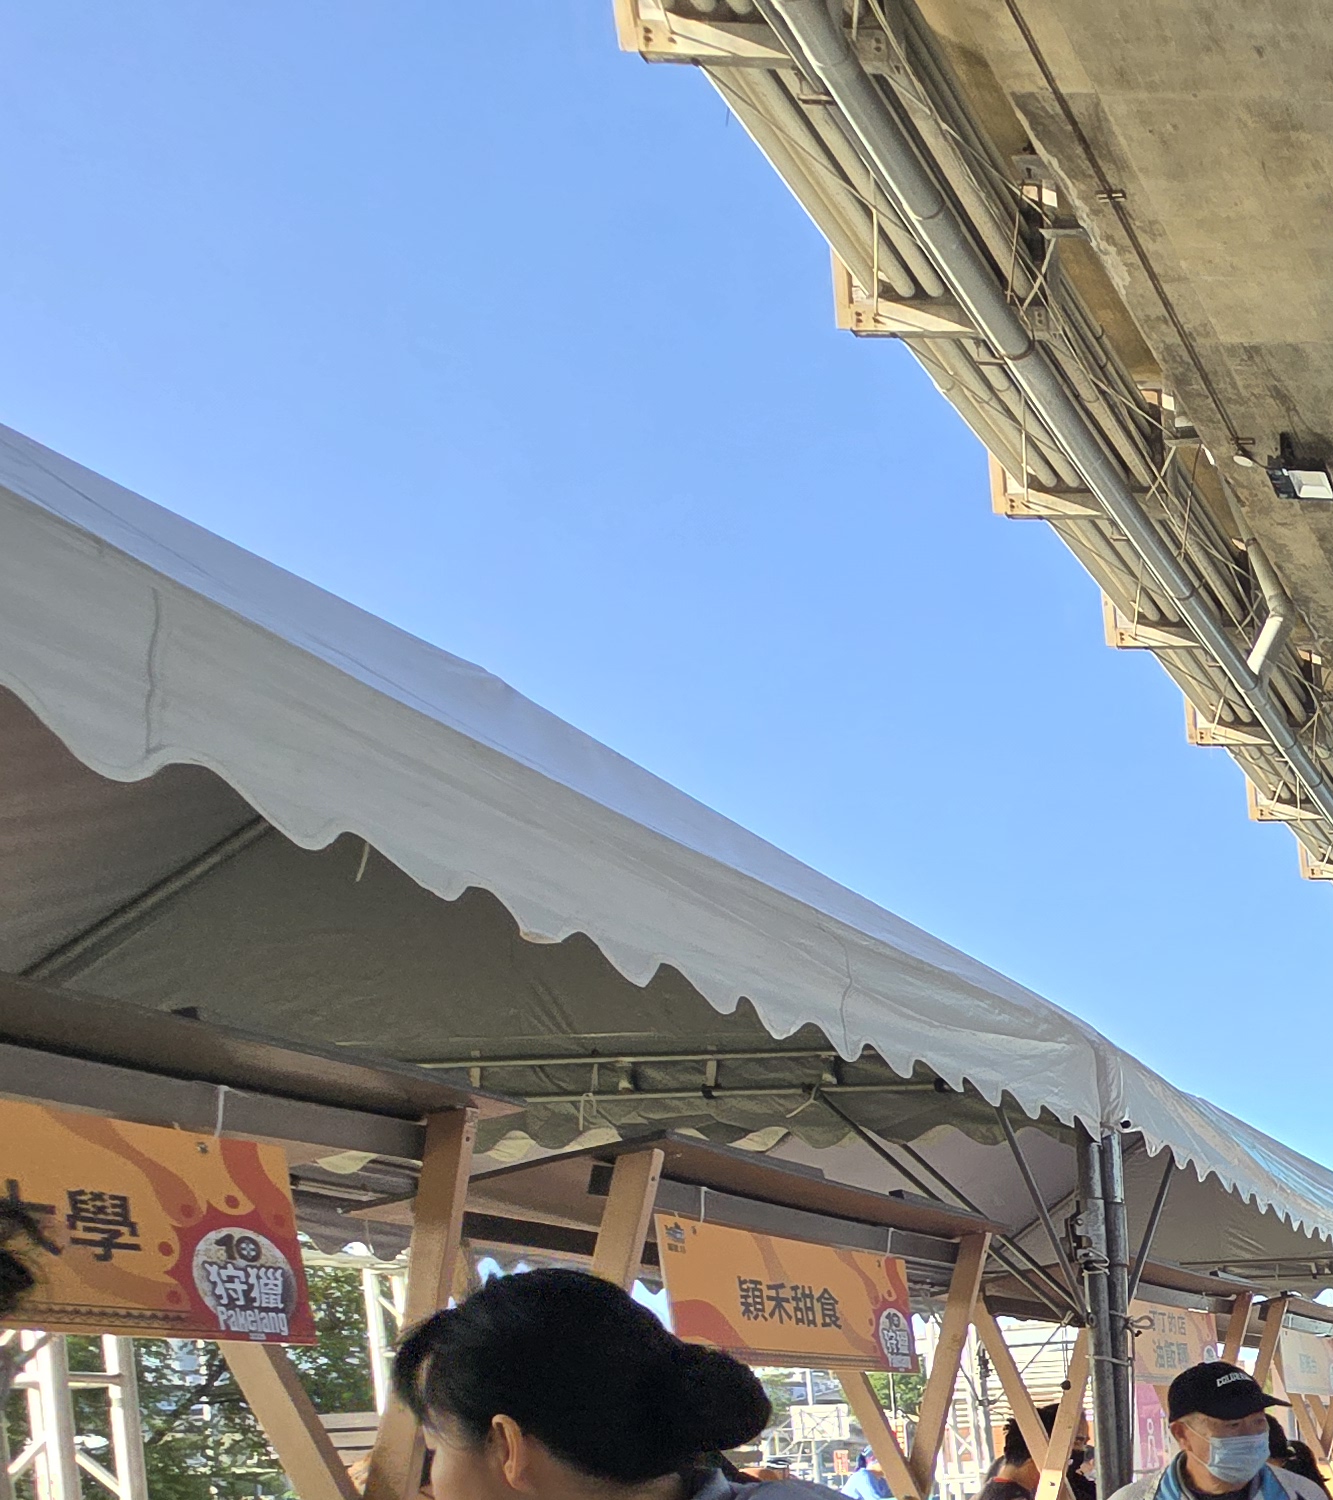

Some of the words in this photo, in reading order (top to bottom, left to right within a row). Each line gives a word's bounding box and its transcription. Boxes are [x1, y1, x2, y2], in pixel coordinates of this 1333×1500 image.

[5, 1179, 141, 1261] 大學
[215, 1234, 262, 1262] 10
[204, 1262, 285, 1309] 狩獵
[218, 1306, 290, 1336] Pakelang
